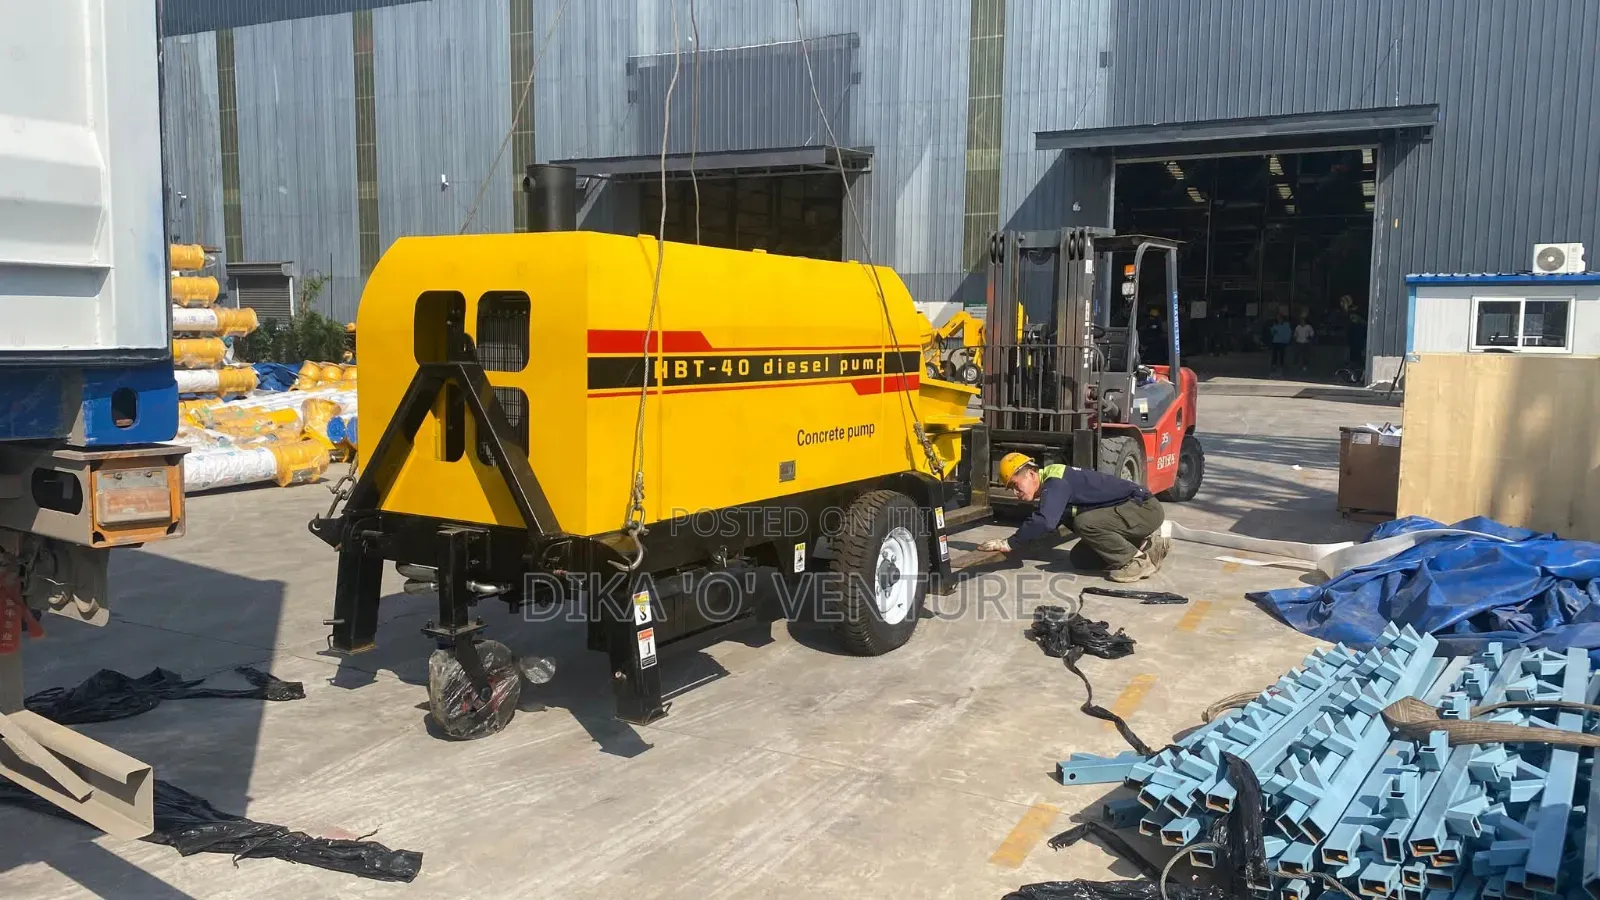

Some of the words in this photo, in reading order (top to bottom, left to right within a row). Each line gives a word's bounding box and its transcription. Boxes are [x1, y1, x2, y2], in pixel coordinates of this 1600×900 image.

[654, 357, 750, 380] HBT-40
[763, 356, 828, 374] diesel
[840, 356, 883, 375] pump
[797, 425, 846, 447] Concrete
[847, 421, 876, 443] pump
